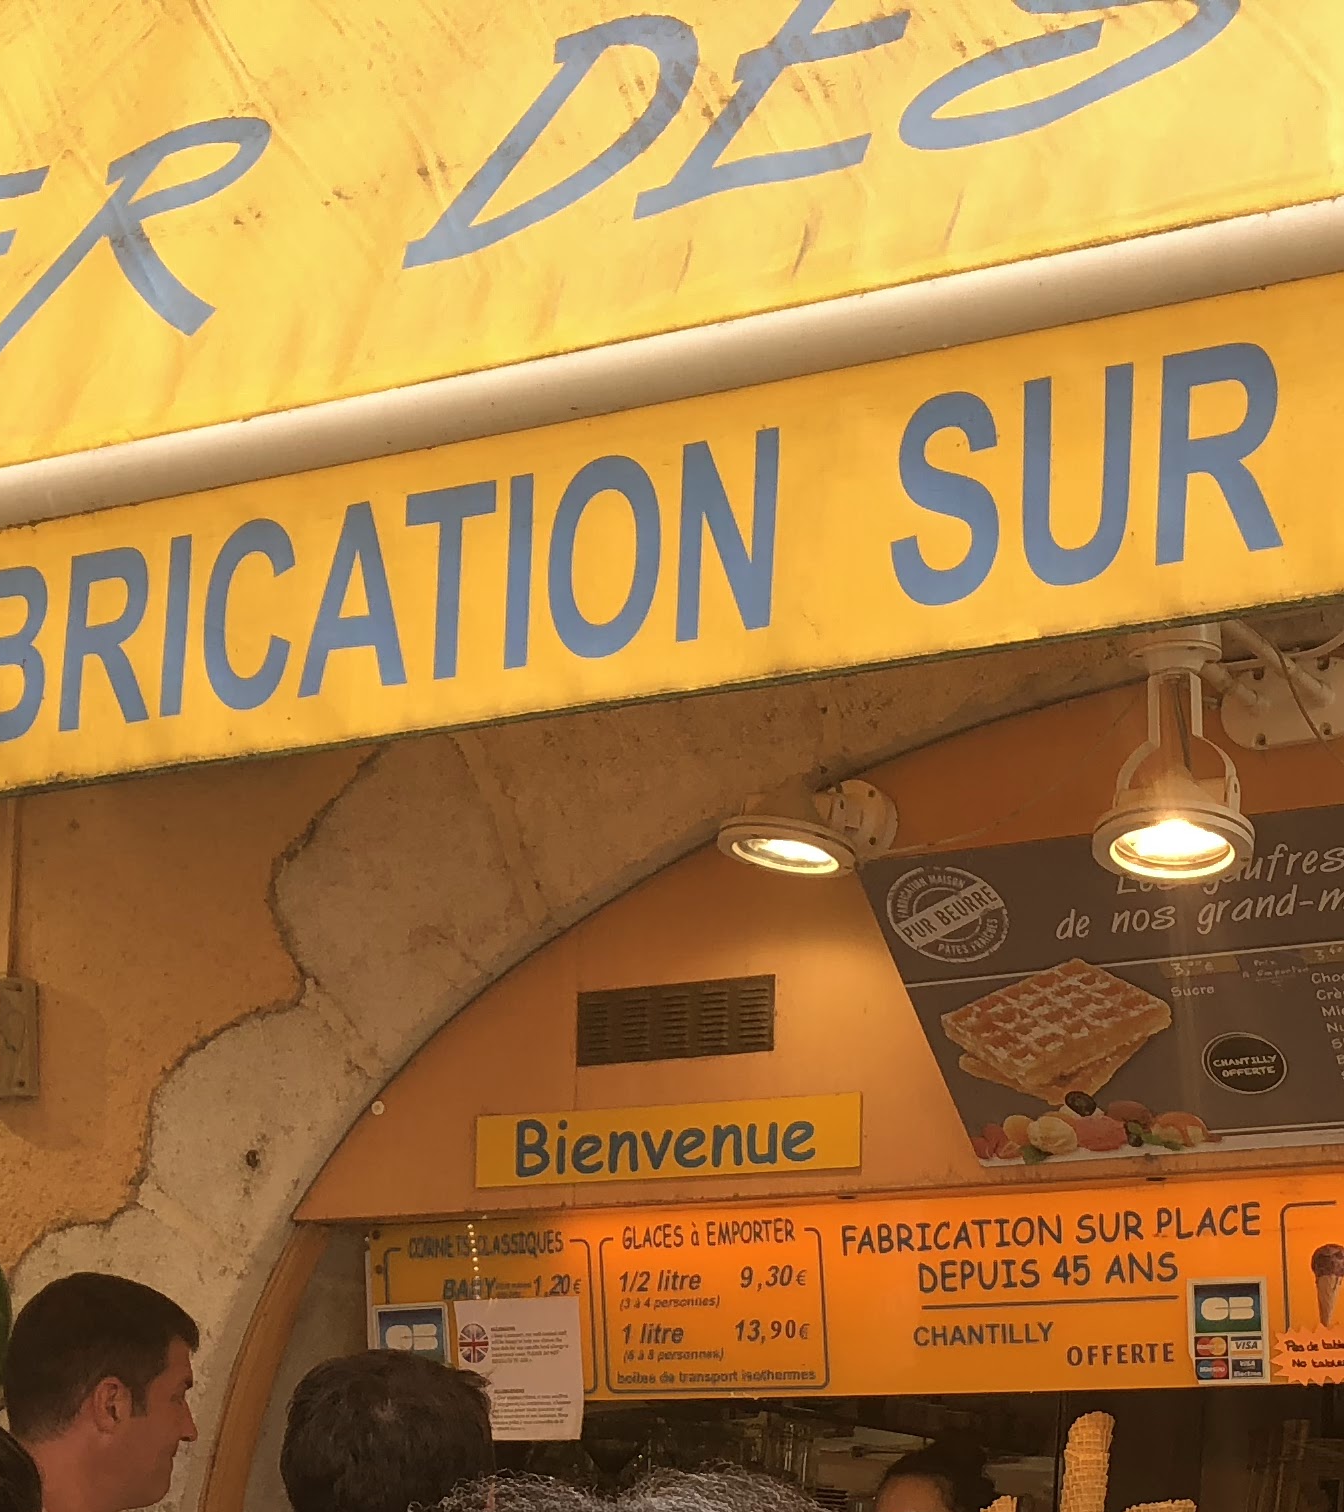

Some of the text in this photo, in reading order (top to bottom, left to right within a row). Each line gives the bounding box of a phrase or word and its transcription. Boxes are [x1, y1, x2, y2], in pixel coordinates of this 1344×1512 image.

[888, 339, 1284, 607] SUR
[901, 885, 998, 943] PUR BEURRE
[1056, 908, 1090, 940] de
[1111, 905, 1176, 934] nos
[1171, 986, 1214, 997] Sucre
[1213, 1054, 1277, 1067] CHANTILLY
[1222, 1065, 1276, 1078] OFFERTE
[515, 1117, 816, 1178] Bienvenue
[622, 1223, 684, 1250] GLACES
[706, 1218, 795, 1246] EMPORTER
[841, 1201, 1262, 1256] FABRICATION SUR PLACE
[619, 1271, 651, 1292] 1/2
[657, 1269, 702, 1292] litre
[918, 1252, 1179, 1293] DEPUIS 45 ANS
[622, 1323, 631, 1344] 1
[640, 1322, 684, 1344] litre
[913, 1321, 1174, 1367] CHANTILLY OFFERTE
[1235, 1341, 1258, 1349] VISA
[1292, 1358, 1307, 1368] No
[679, 1370, 738, 1386] transport
[741, 1369, 816, 1383] isothermes
